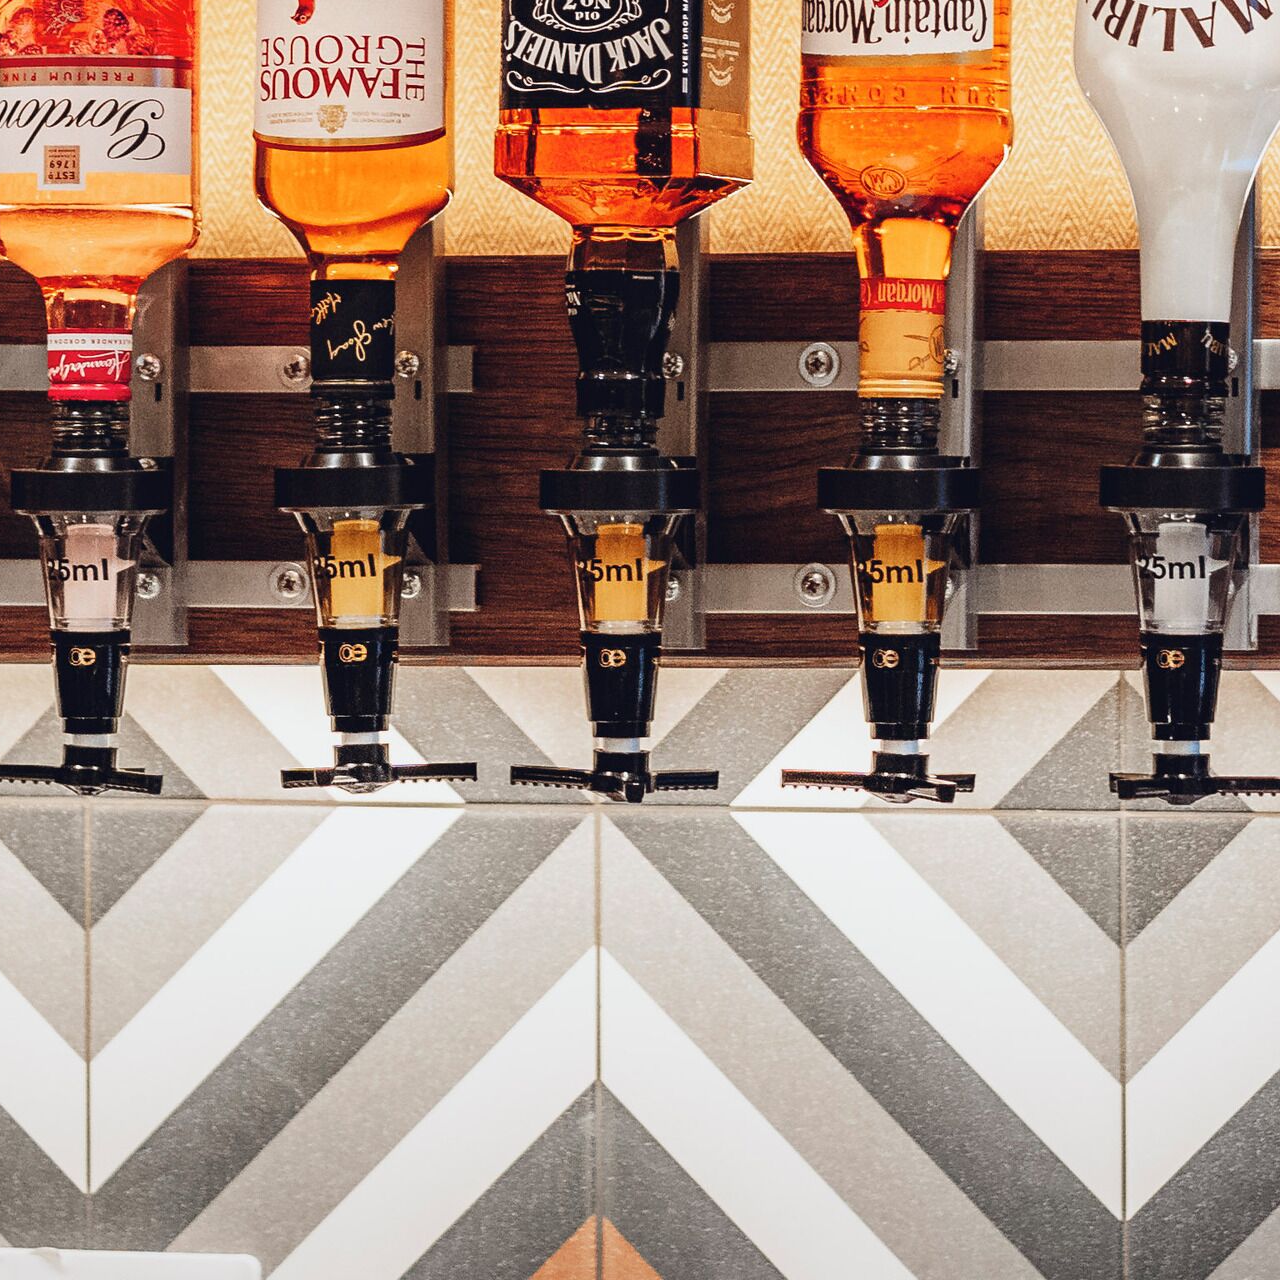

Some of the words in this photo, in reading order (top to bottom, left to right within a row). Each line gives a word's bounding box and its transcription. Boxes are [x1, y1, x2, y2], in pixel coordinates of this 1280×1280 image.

[574, 11, 600, 21] Old
[260, 35, 403, 67] GROUSE
[503, 16, 603, 84] DANIEL'S
[603, 18, 674, 73] JACK
[681, 41, 689, 73] EVERY
[1, 72, 37, 82] PINK
[49, 72, 134, 82] PREMIUM
[260, 67, 402, 102] FAMOUS
[405, 37, 426, 102] THE
[49, 160, 75, 168] 1769
[877, 279, 935, 310] Morgan
